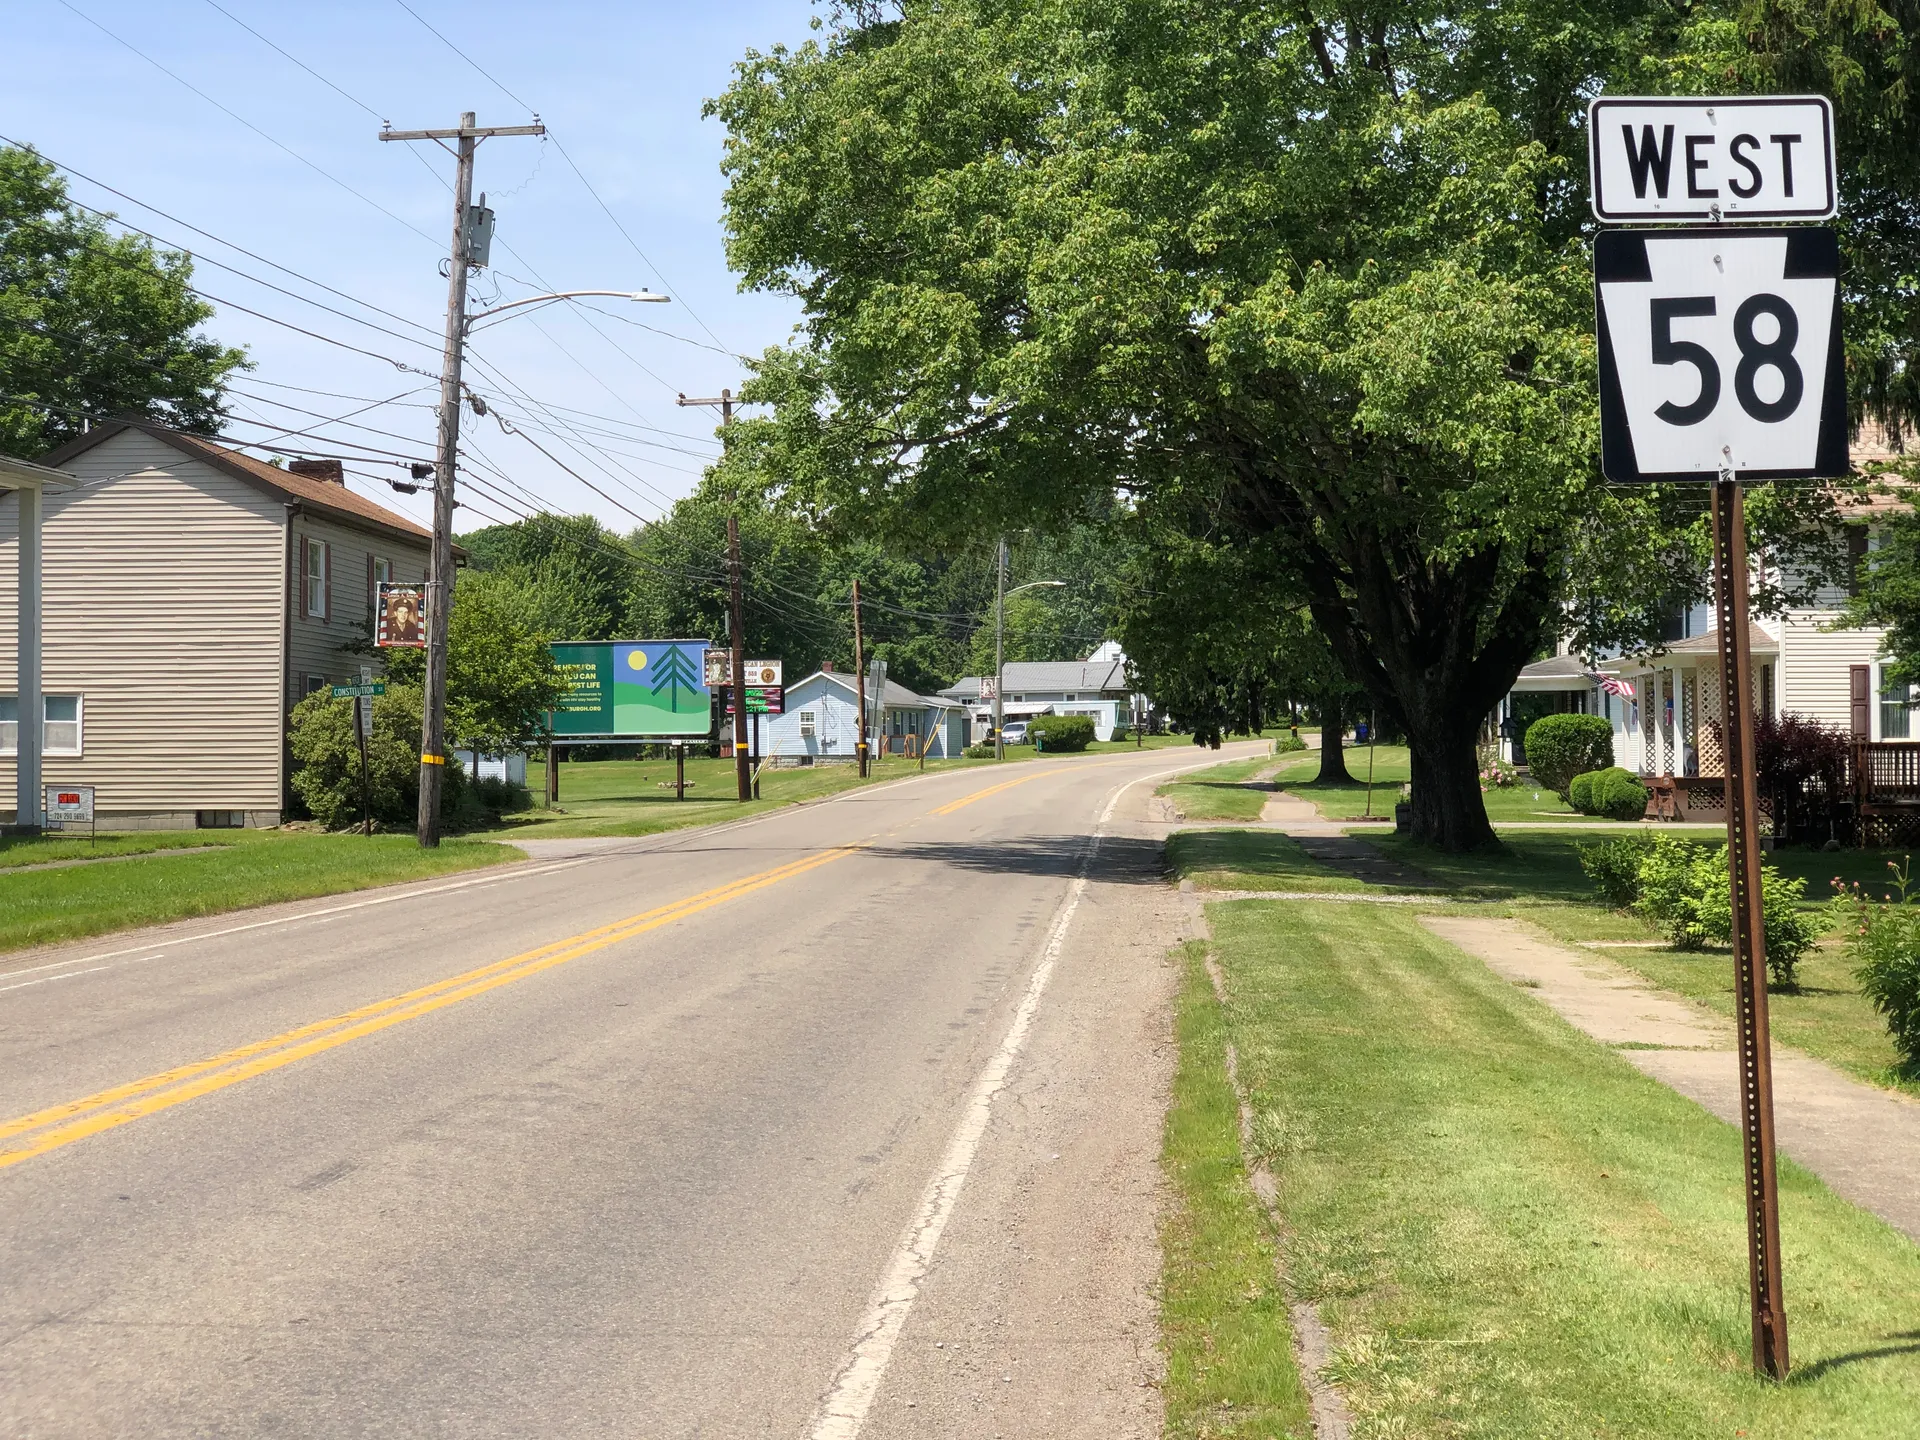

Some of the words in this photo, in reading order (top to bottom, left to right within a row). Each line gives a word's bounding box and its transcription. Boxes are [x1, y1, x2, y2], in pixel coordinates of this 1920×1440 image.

[1621, 124, 1802, 199] WEST
[1650, 293, 1804, 427] 58
[334, 685, 375, 697] CONSTITUTION
[586, 681, 601, 689] LIFE
[54, 812, 63, 820] 724
